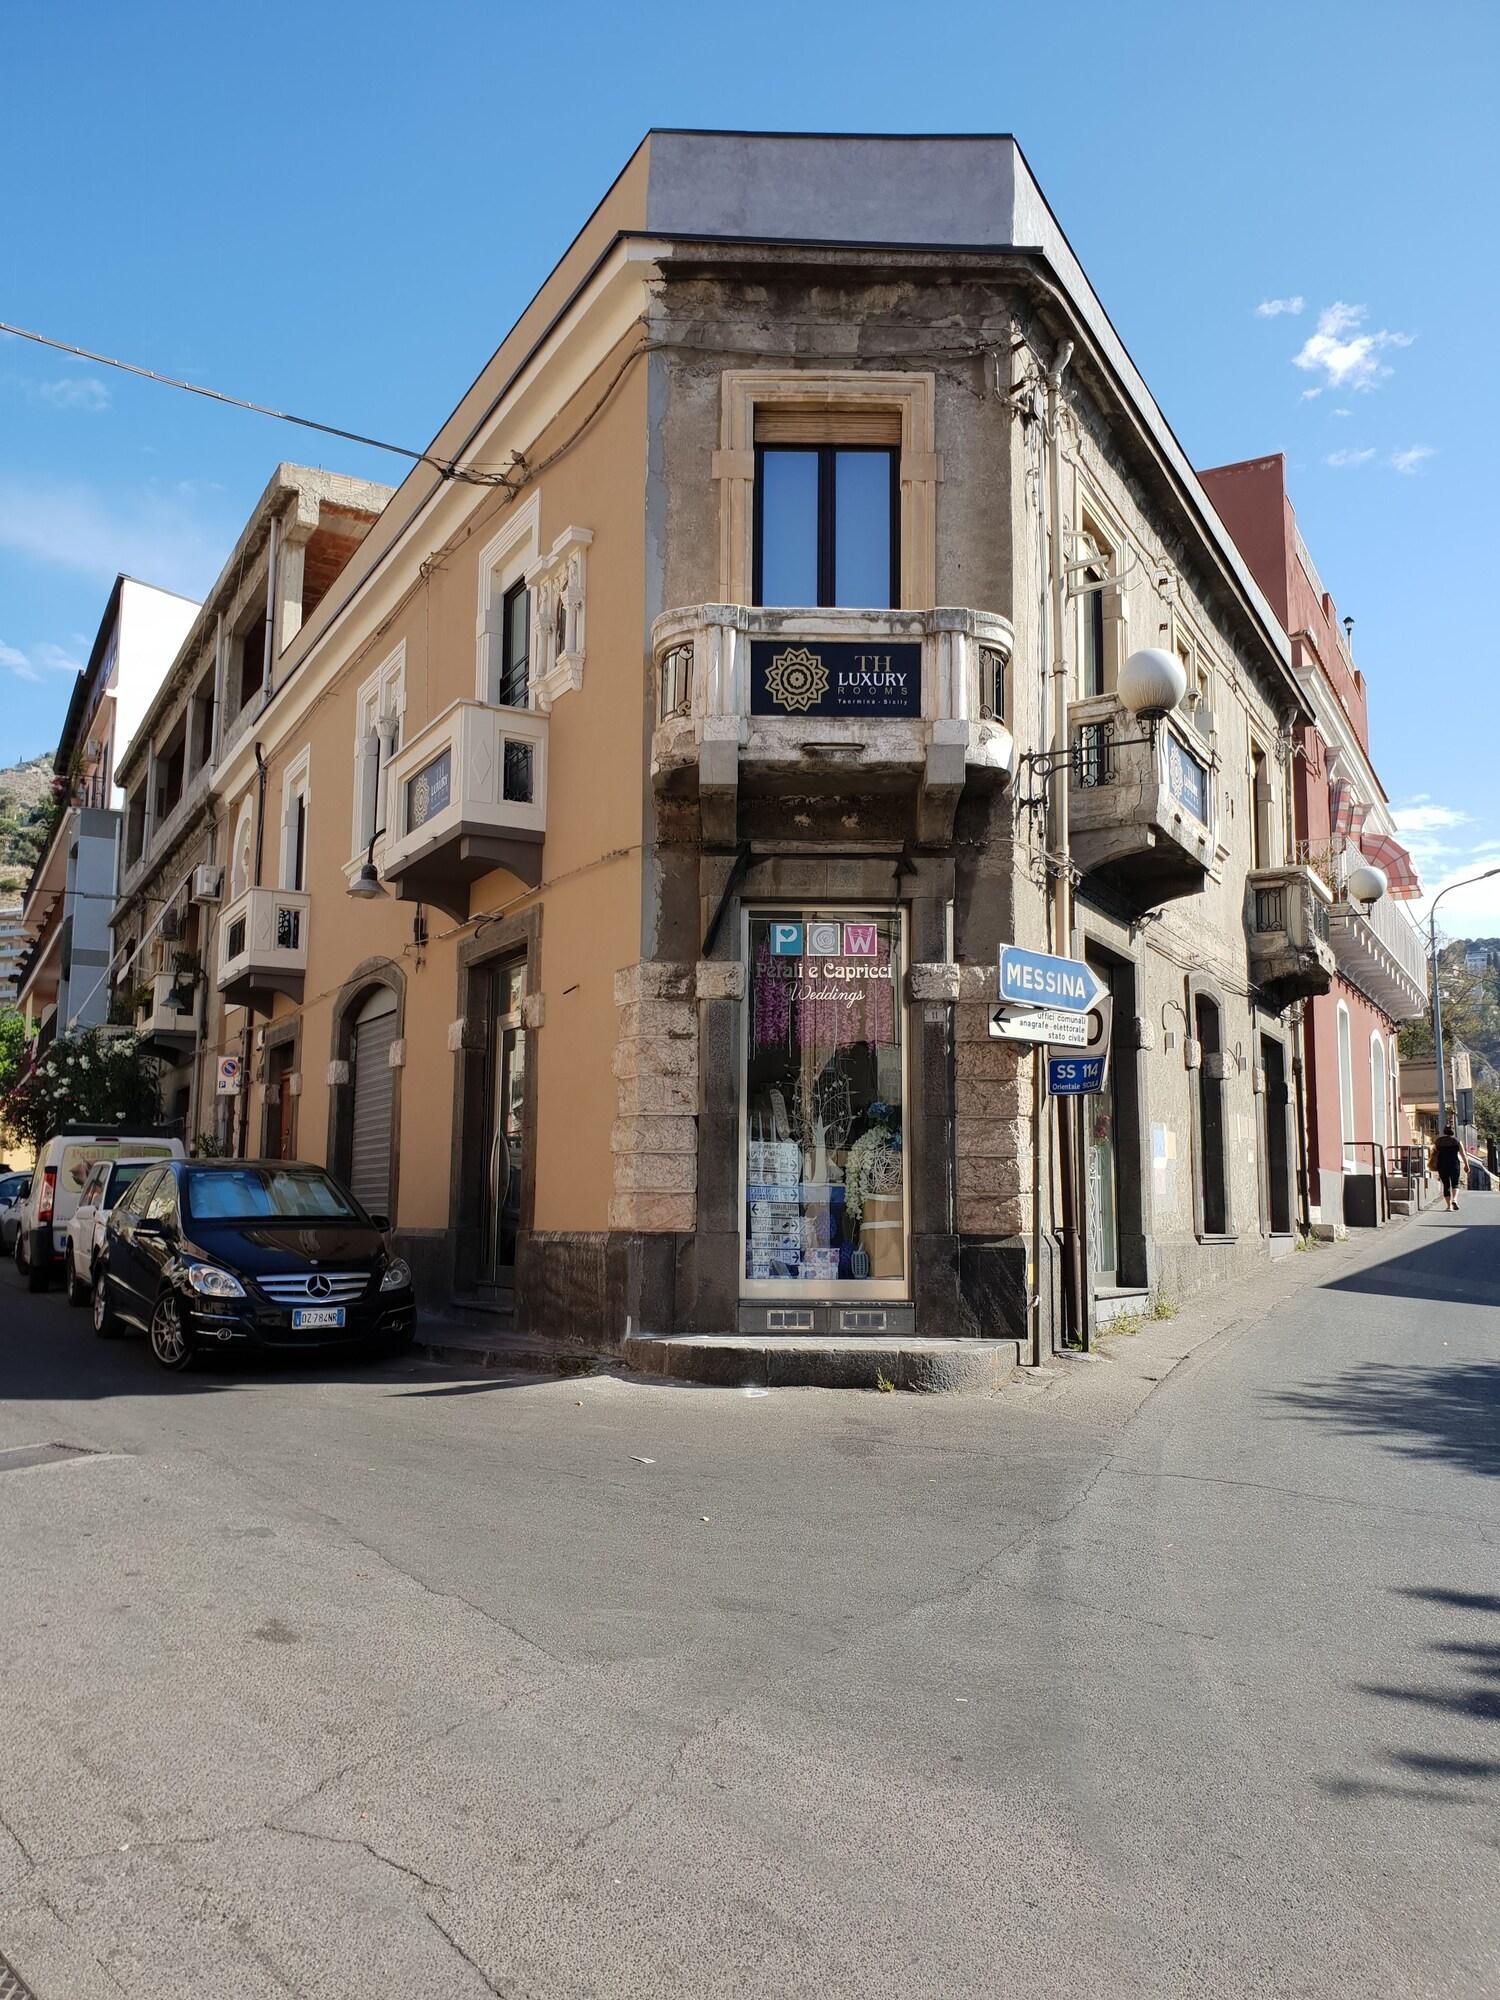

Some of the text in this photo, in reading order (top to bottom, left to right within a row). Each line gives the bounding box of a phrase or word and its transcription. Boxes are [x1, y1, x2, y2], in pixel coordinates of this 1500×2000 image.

[854, 655, 892, 672] TH
[838, 672, 907, 686] LUXURY
[838, 687, 908, 695] ROOMS
[808, 964, 819, 978] e
[823, 963, 893, 981] Capricci
[1007, 962, 1086, 999] MESSINA
[784, 982, 866, 1008] Weddings
[1037, 1010, 1086, 1025] uffici comunali
[1020, 1019, 1049, 1029] anagrafe
[1054, 1022, 1085, 1033] elettorale
[1048, 1032, 1085, 1043] stato civile
[1057, 1063, 1099, 1079] SS 114
